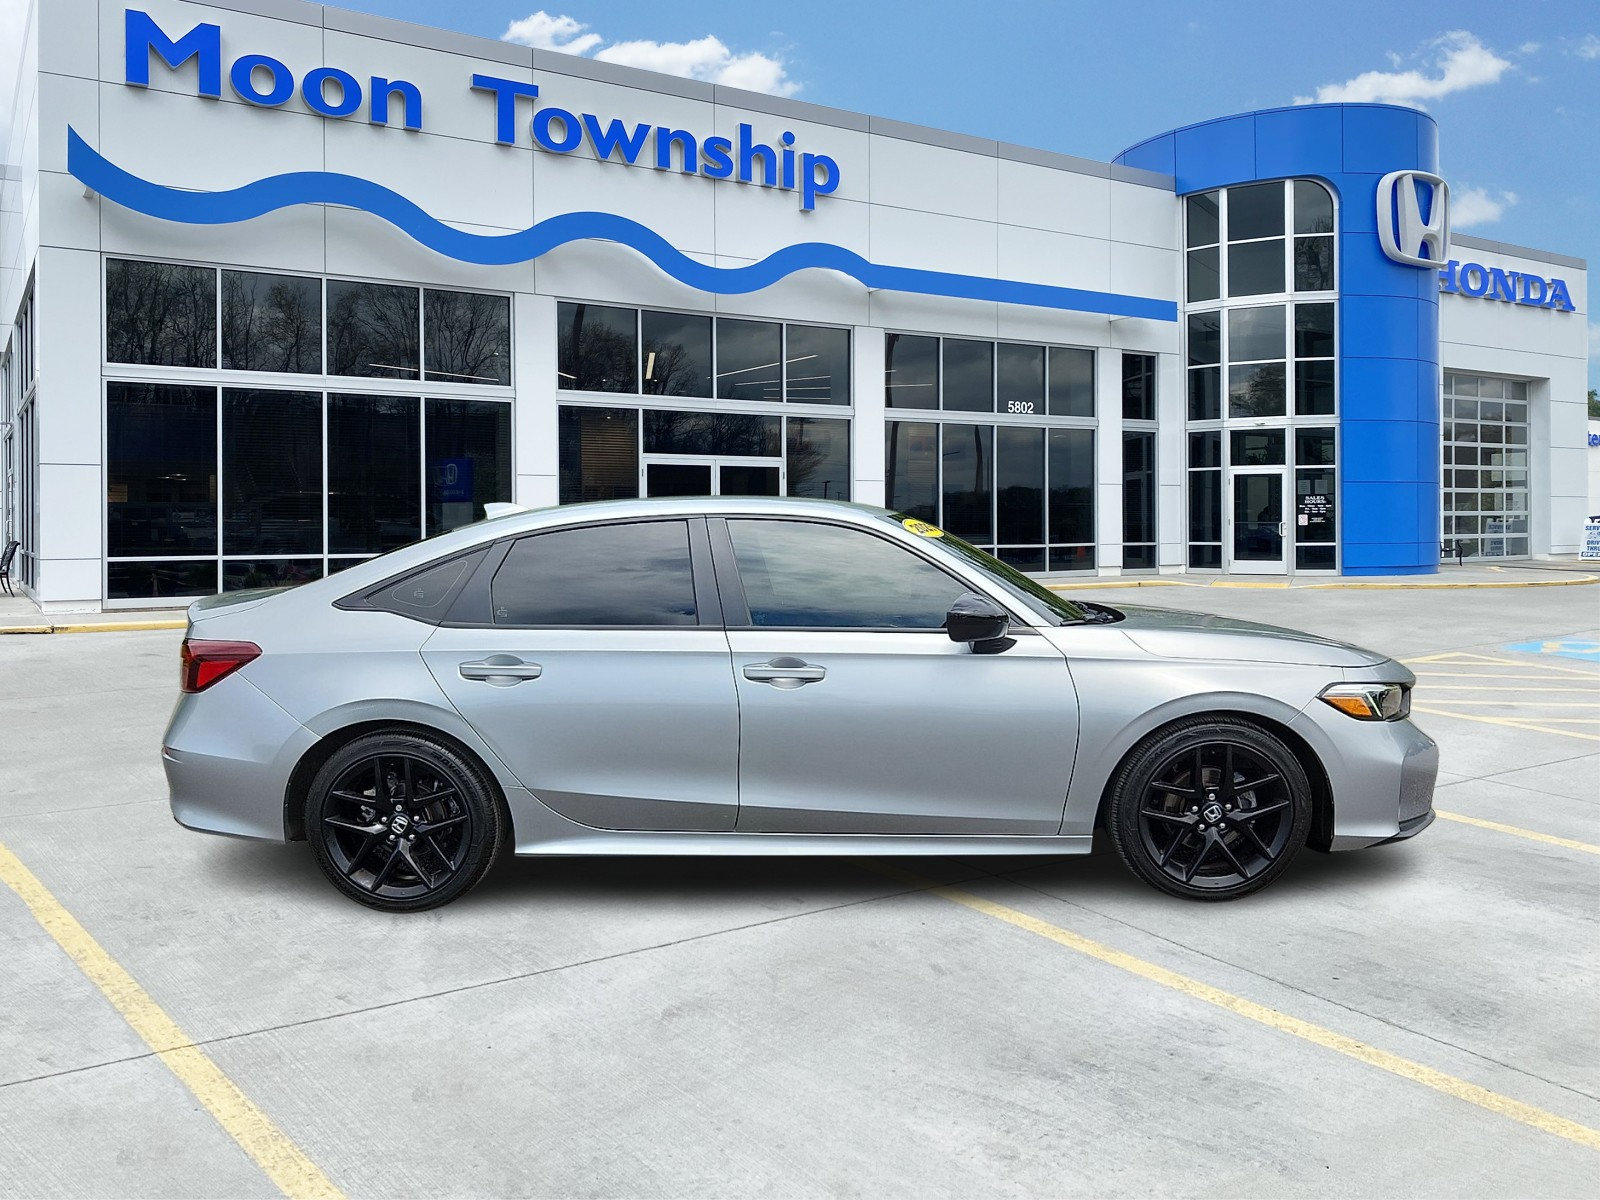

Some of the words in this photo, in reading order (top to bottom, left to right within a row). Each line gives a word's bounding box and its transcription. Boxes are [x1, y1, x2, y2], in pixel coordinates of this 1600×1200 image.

[125, 8, 422, 132] Moon
[470, 73, 841, 213] Township
[1438, 259, 1576, 311] HONDA
[1007, 400, 1034, 414] 5802
